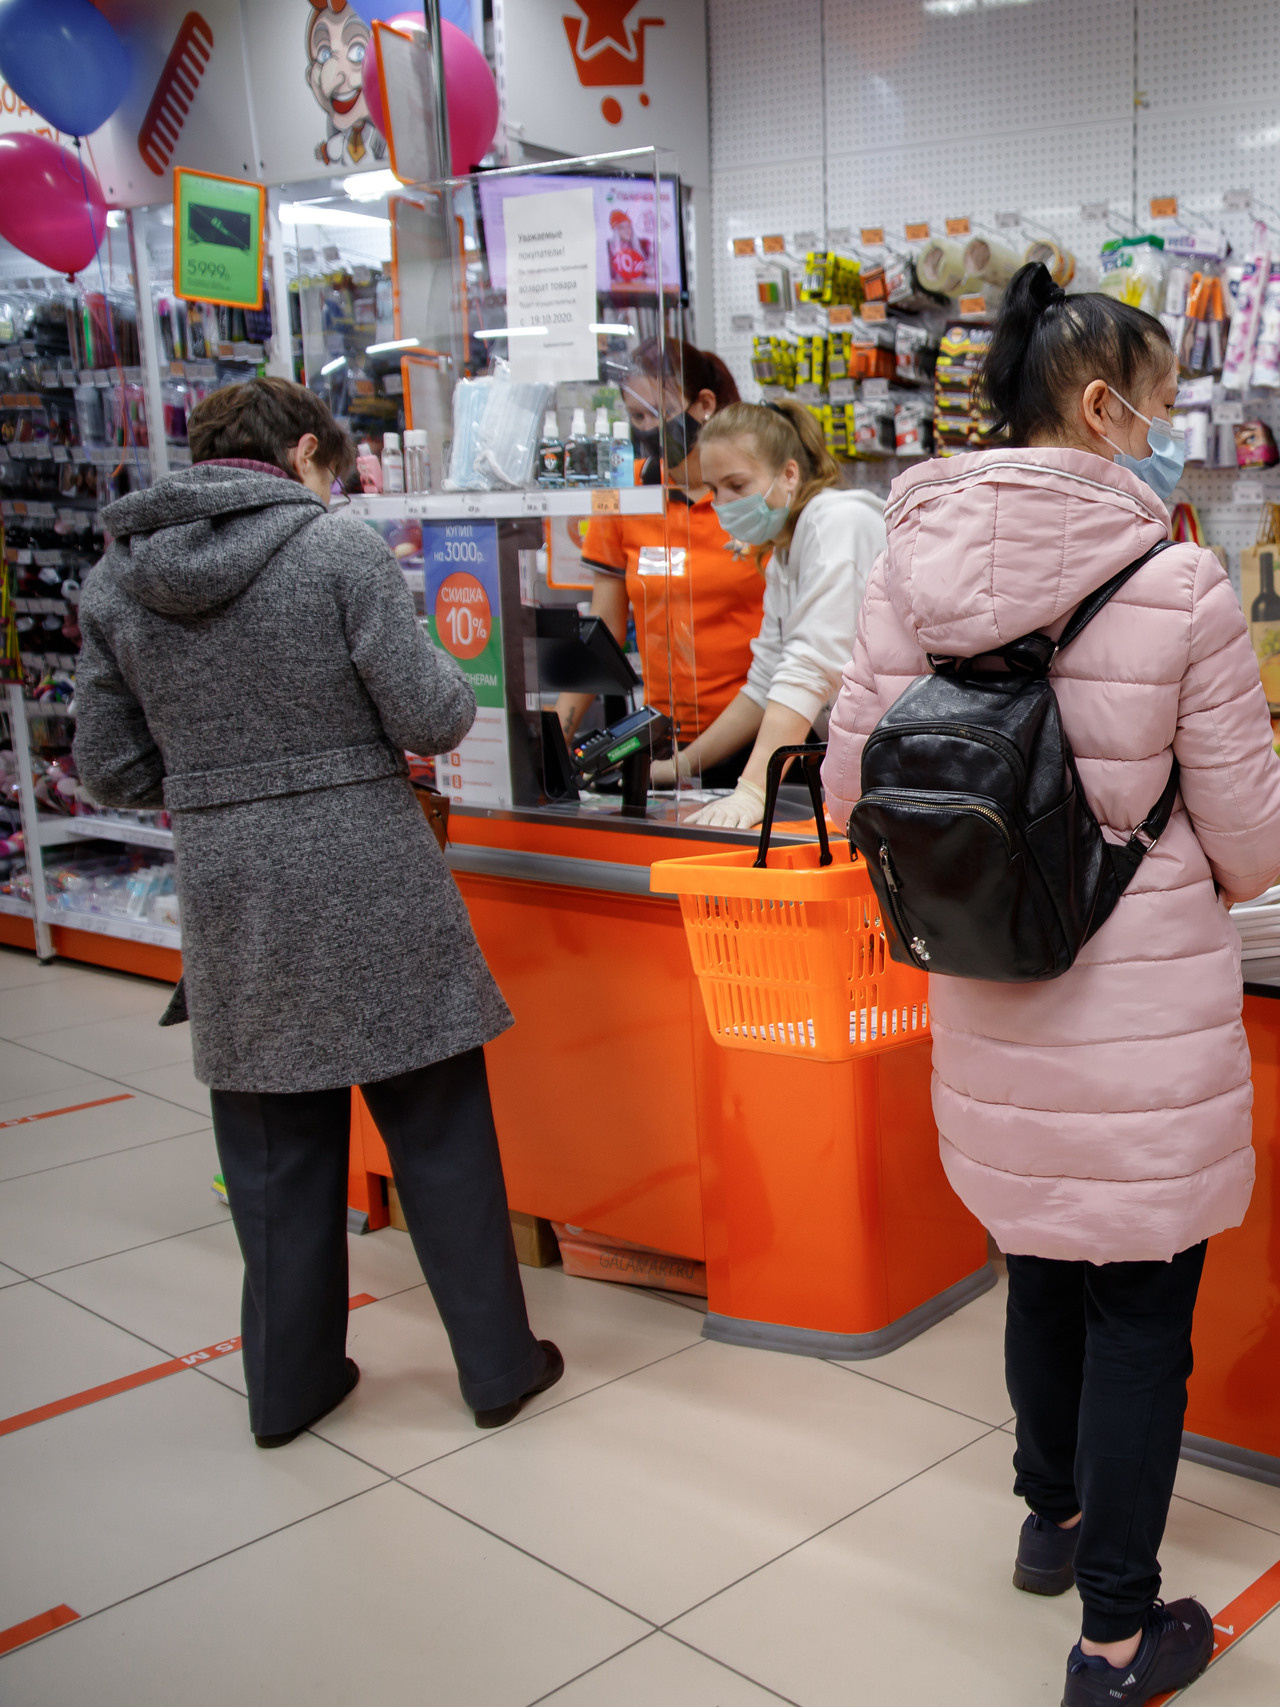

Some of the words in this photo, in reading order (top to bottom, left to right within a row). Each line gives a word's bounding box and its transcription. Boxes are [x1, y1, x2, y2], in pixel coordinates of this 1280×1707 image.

[518, 230, 563, 243] Уважаемые
[445, 525, 473, 537] КУПИЛ
[441, 586, 483, 604] СКИДКА
[446, 607, 487, 645] 10%
